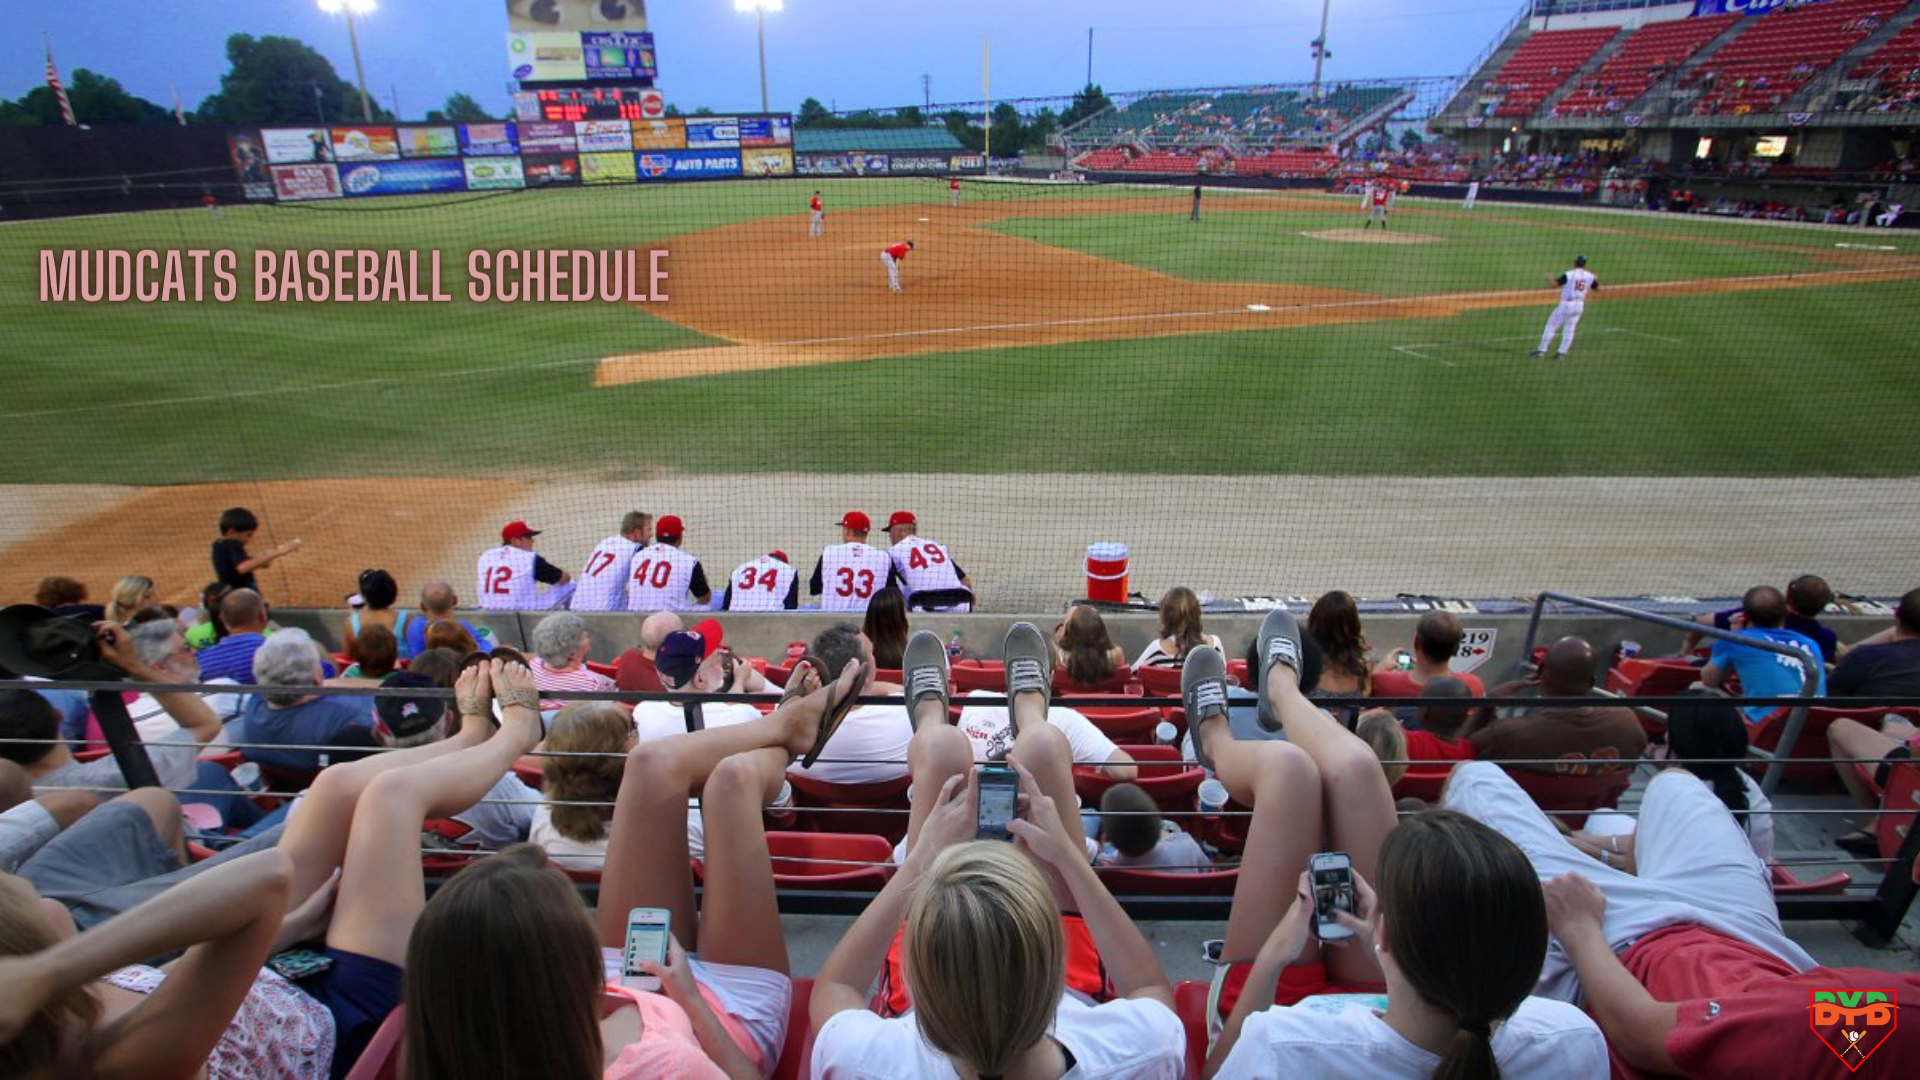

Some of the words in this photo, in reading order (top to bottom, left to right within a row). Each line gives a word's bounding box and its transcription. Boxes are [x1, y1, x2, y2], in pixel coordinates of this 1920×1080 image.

[674, 159, 703, 171] AUTO
[705, 157, 738, 170] PARTS
[585, 549, 616, 577] 17
[909, 543, 945, 570] 49
[484, 566, 512, 594] 12
[634, 558, 672, 589] 40
[738, 567, 778, 592] 34
[836, 567, 875, 598] 33
